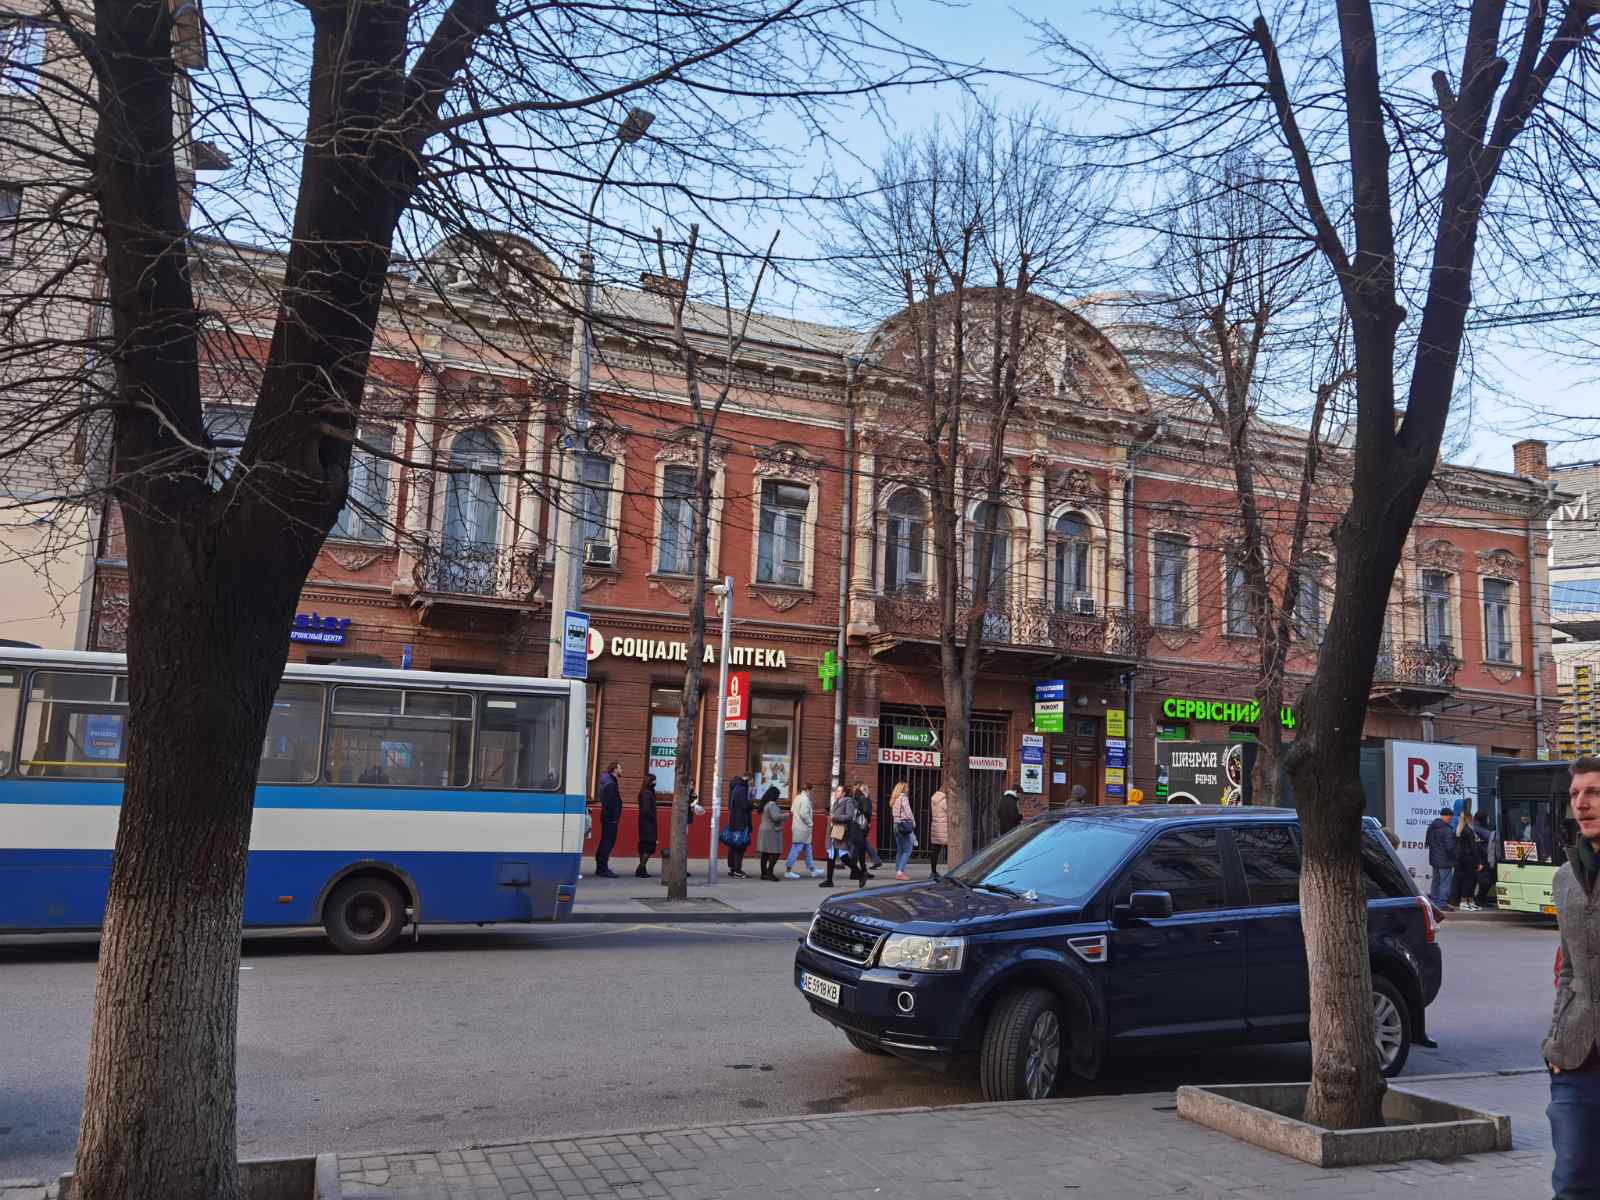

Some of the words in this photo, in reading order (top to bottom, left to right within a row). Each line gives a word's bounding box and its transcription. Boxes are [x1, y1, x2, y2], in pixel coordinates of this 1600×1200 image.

[611, 636, 715, 663] СОЦІАЛЬА
[1163, 697, 1261, 723] СЕРВІСНИЙ
[859, 727, 869, 737] 12
[882, 749, 935, 767] ВЫЕЗД
[1171, 751, 1218, 768] ШАУРМА
